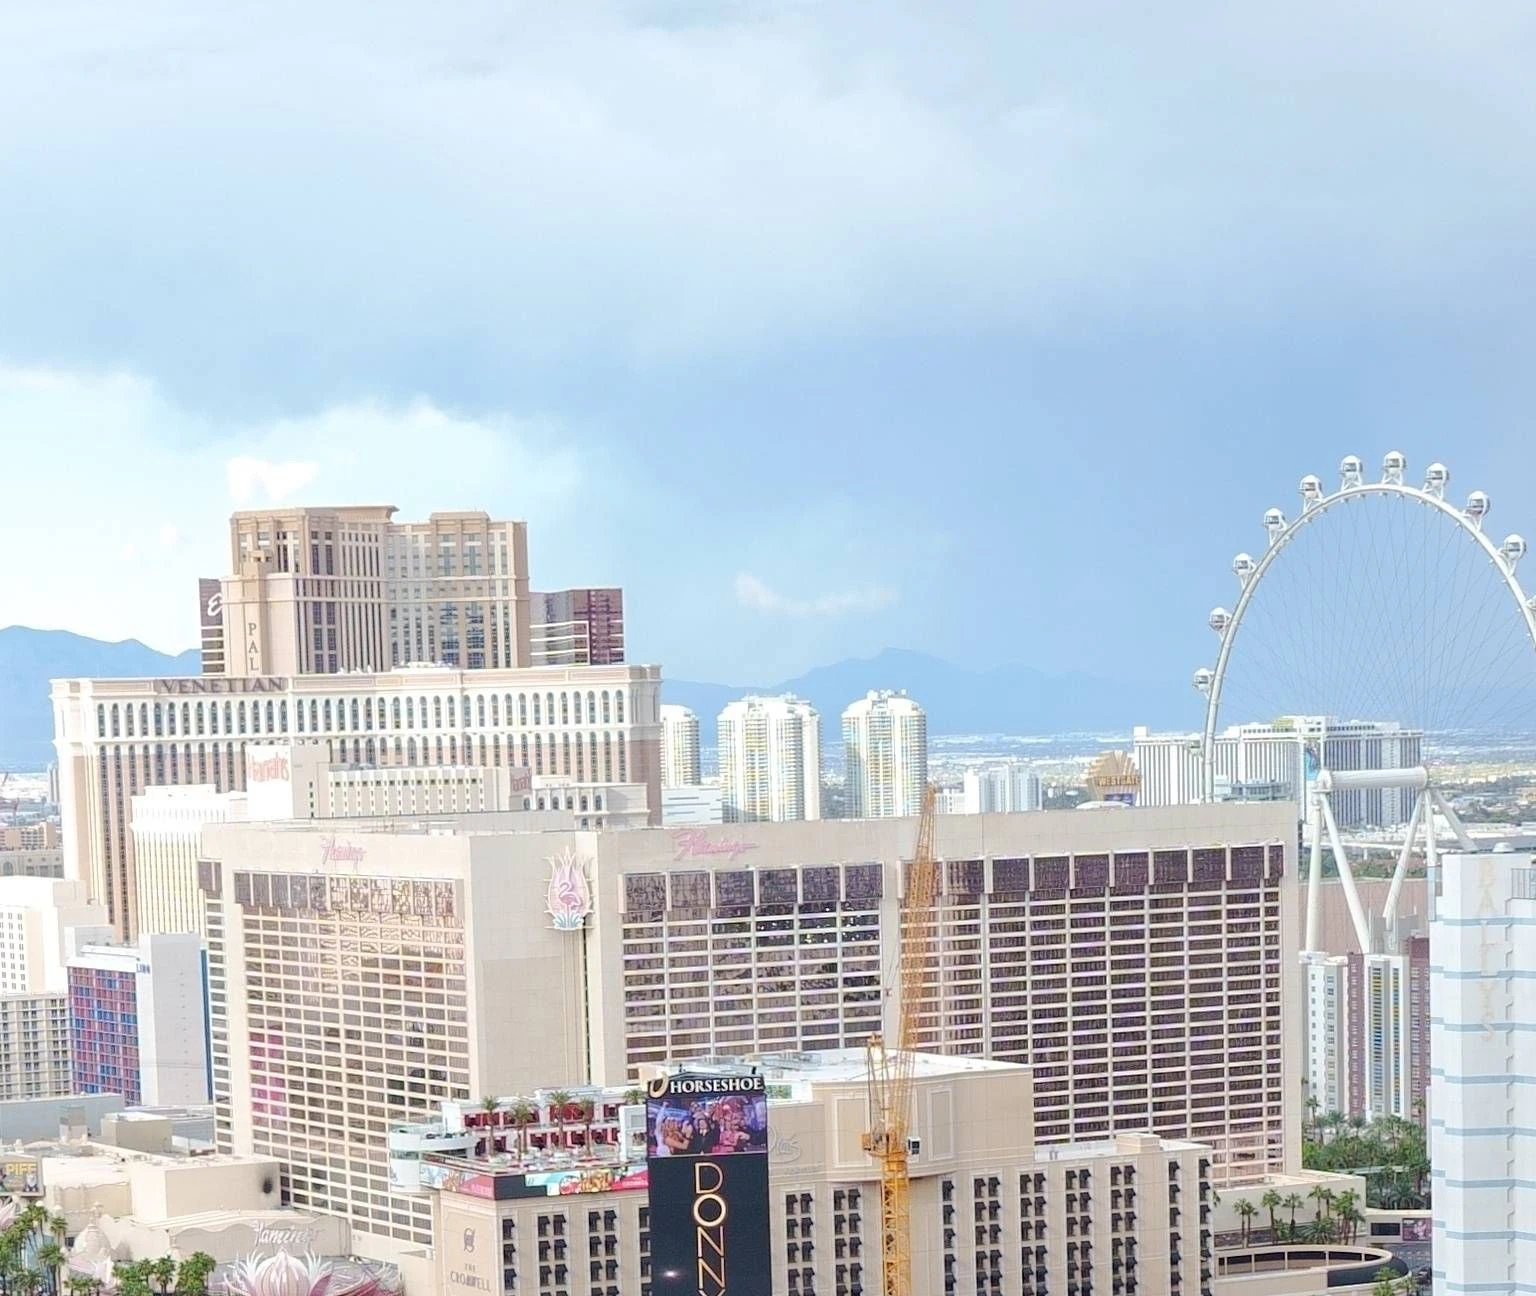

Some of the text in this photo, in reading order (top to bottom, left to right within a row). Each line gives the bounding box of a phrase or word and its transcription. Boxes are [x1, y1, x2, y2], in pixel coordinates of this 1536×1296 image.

[163, 679, 283, 694] VENETIAN
[670, 1077, 764, 1094] HORSESHOE
[450, 1272, 492, 1292] CROMWELL
